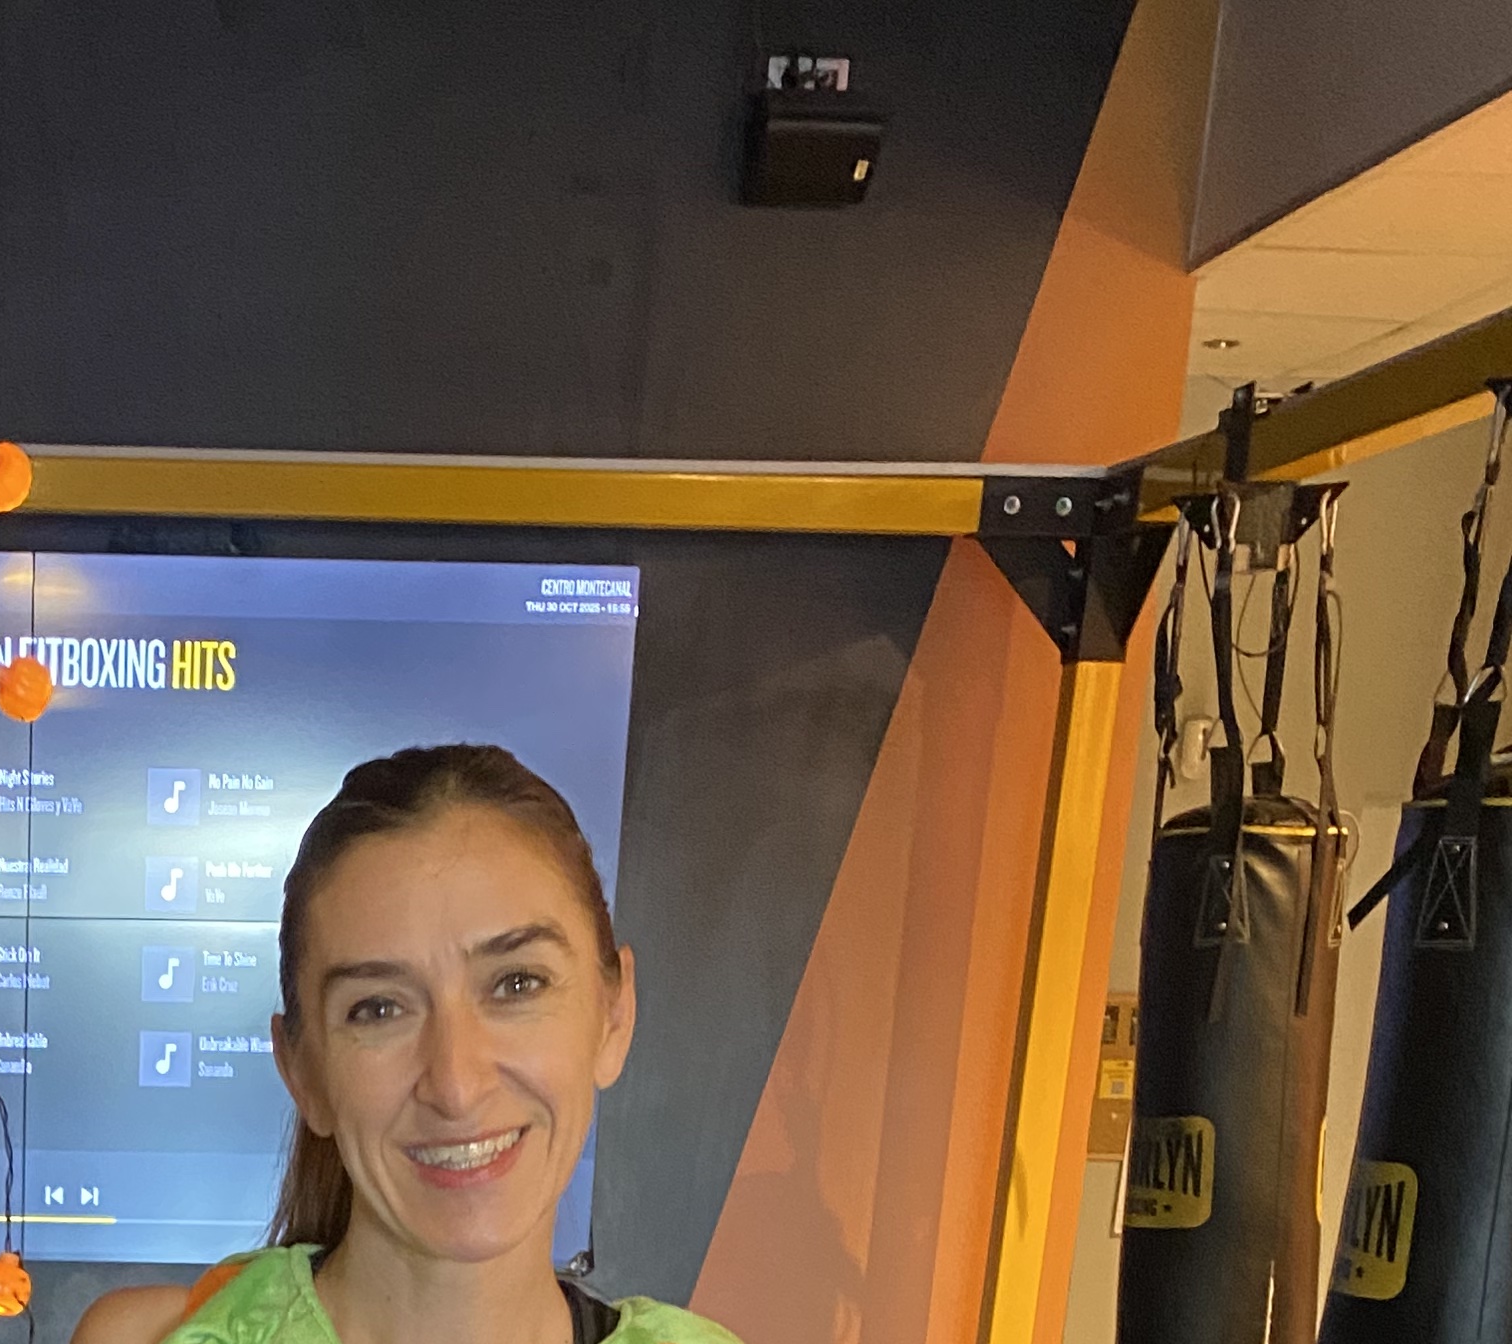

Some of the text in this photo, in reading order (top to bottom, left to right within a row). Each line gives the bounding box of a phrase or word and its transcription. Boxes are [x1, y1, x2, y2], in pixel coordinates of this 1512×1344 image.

[541, 579, 632, 597] CENTRO MONTECANAL
[526, 601, 546, 612] THU
[547, 601, 557, 612] 30
[559, 602, 578, 613] OCT
[171, 640, 237, 691] HITS
[22, 769, 55, 786] Stories
[208, 773, 274, 790] No Pain No Gain
[203, 951, 257, 967] Time To Shine
